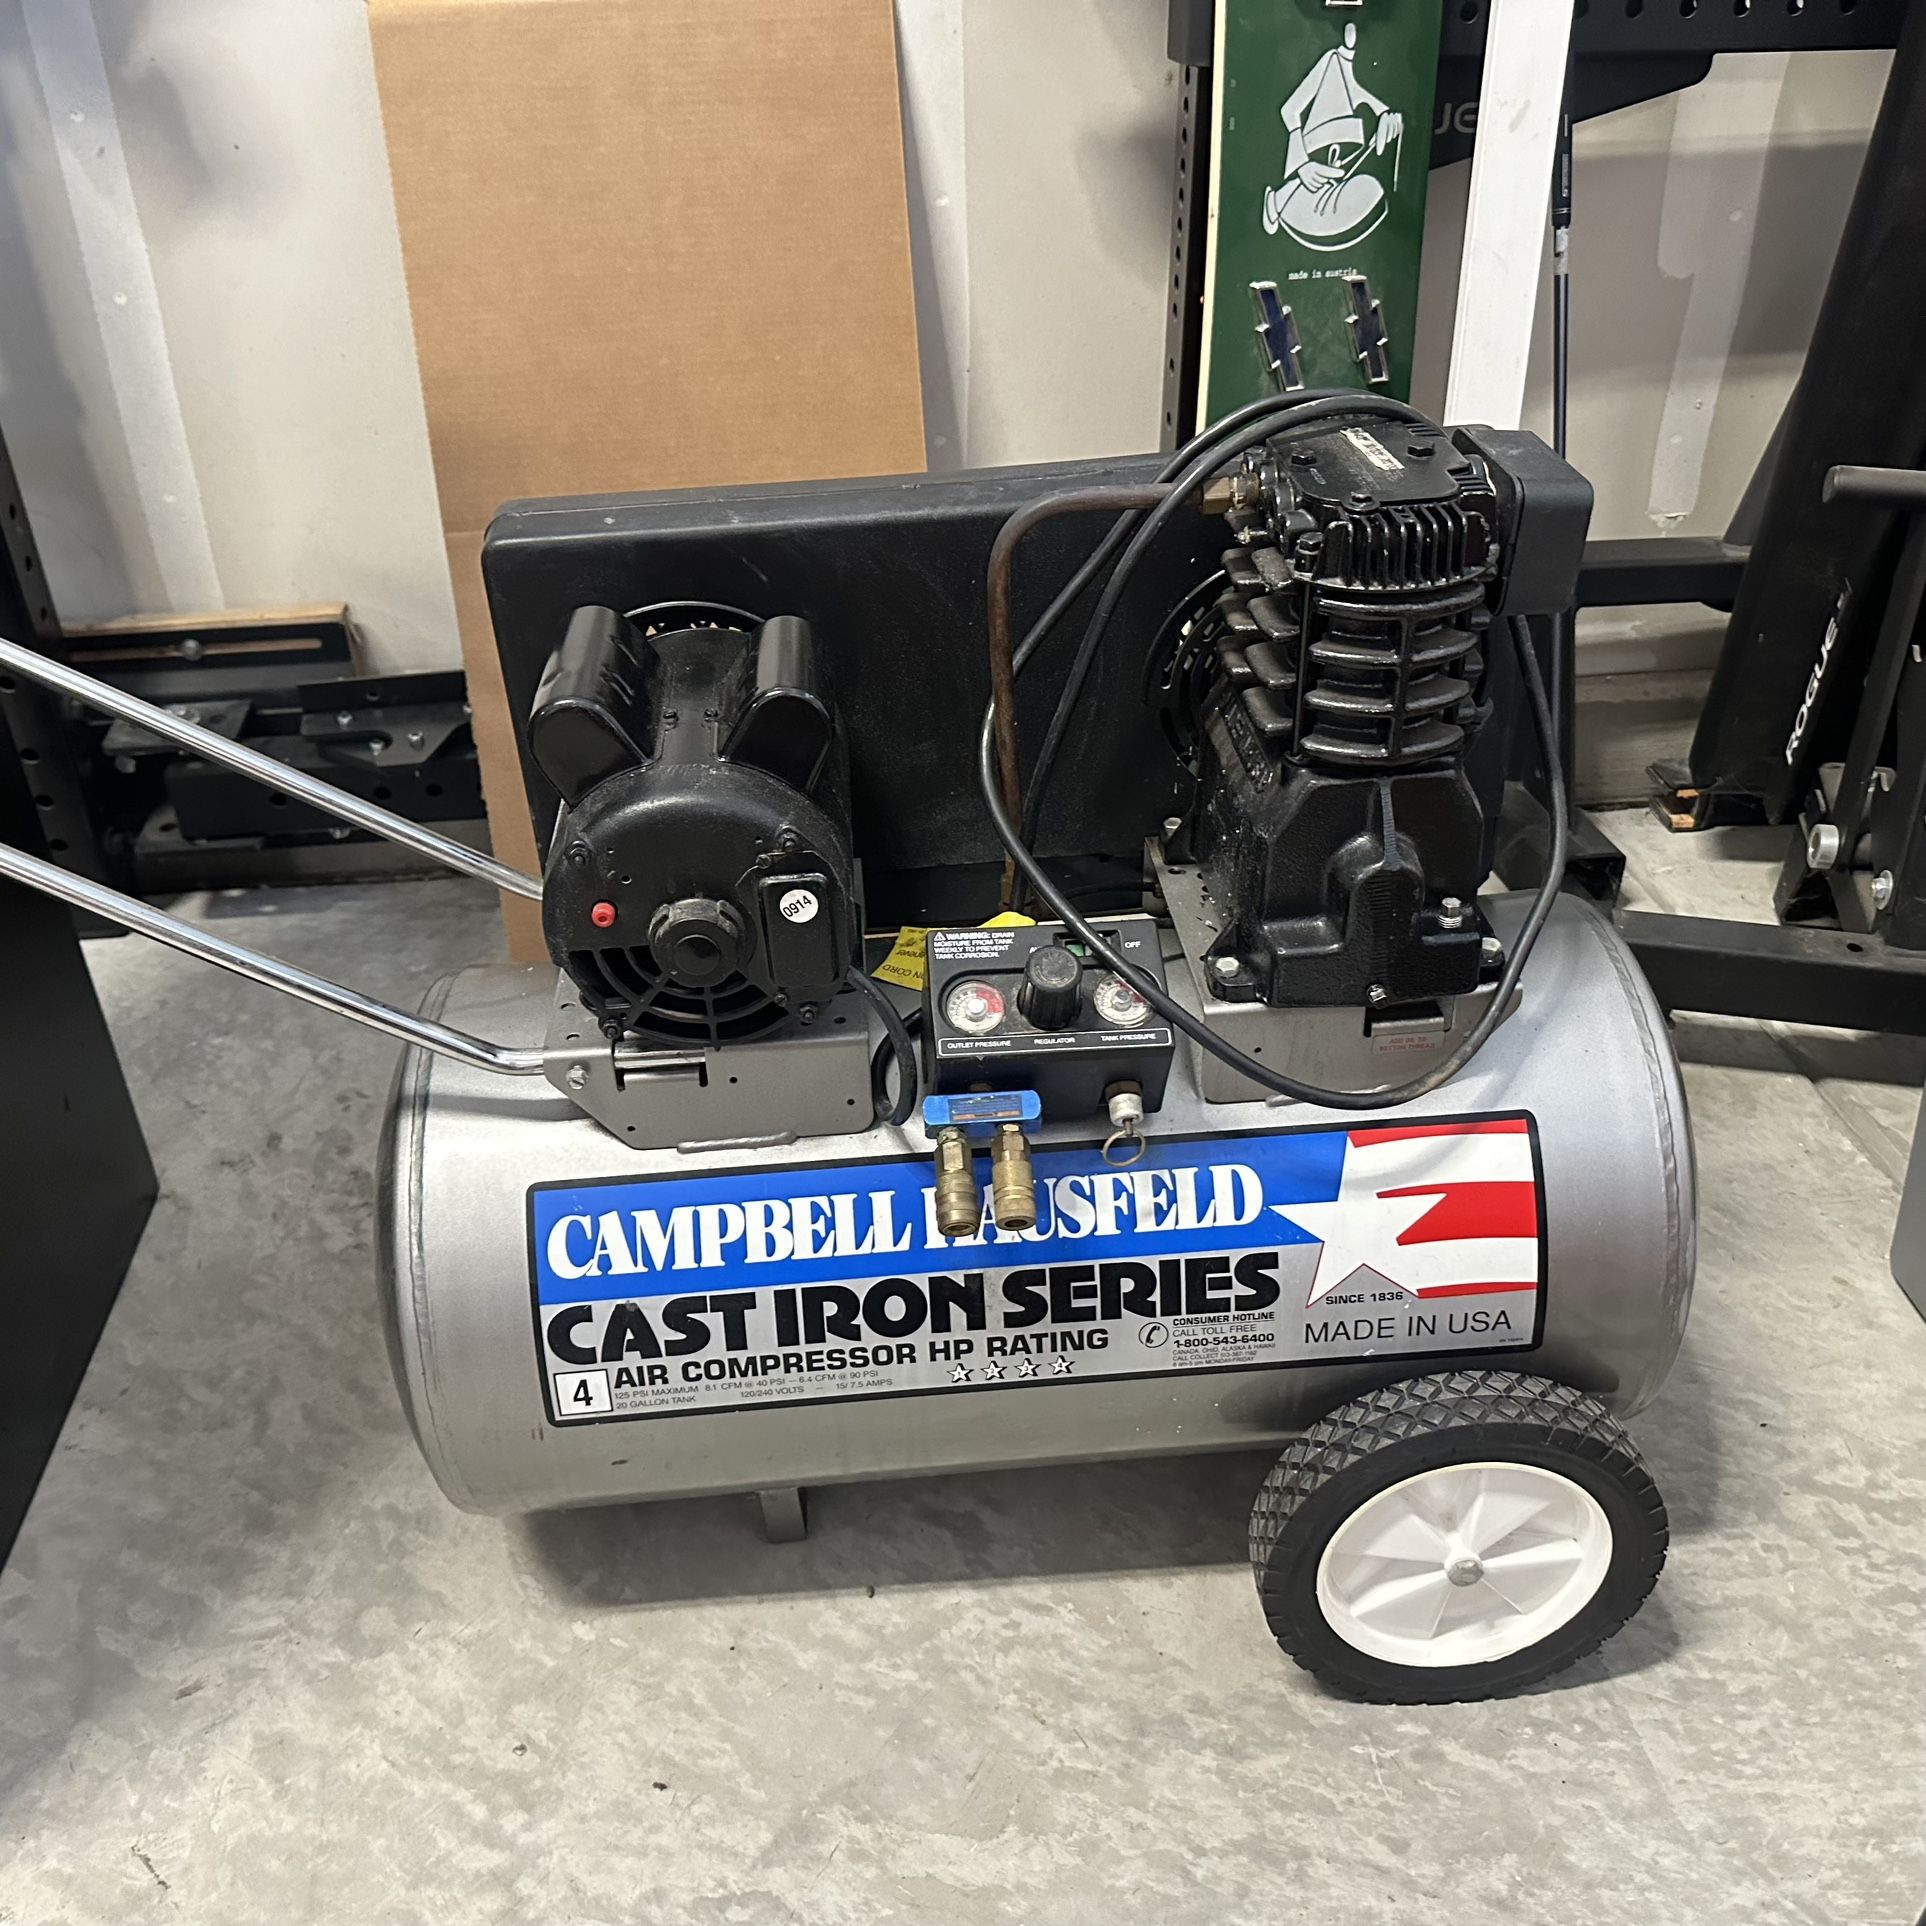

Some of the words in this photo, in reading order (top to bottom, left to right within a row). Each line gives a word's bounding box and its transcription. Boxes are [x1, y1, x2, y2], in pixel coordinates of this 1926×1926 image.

[1288, 270, 1308, 280] made
[1312, 269, 1322, 278] in
[1786, 617, 1838, 766] ROGUE
[783, 895, 812, 917] 0914
[946, 932, 990, 940] WARNING:
[882, 964, 912, 976] CORD
[947, 1041, 973, 1049] OUTLET
[974, 1040, 1011, 1048] PRESSURE
[1034, 1037, 1076, 1045] REGULATOR
[547, 1190, 912, 1280] CAMPBELL
[1325, 1294, 1365, 1305] SINCE
[1371, 1291, 1404, 1302] 1836
[548, 1292, 756, 1365] CAST
[774, 1273, 986, 1347] IRON
[1002, 1252, 1281, 1329] SERIES
[1173, 1315, 1230, 1326] CONSUMER
[1232, 1312, 1275, 1321] HOTLINE
[1304, 1317, 1396, 1344] MADE
[1407, 1314, 1436, 1337] IN
[1449, 1310, 1512, 1334] USA
[1172, 1329, 1198, 1337] CALL
[1201, 1327, 1225, 1335] TOLL
[1229, 1324, 1256, 1332] FREE
[1173, 1333, 1275, 1348] 1-800-543-6400
[614, 1364, 669, 1389] AIR
[681, 1342, 916, 1382] COMPRESSOR
[929, 1339, 973, 1361] HP
[987, 1328, 1109, 1357] RATING
[573, 1379, 593, 1406] 4
[614, 1391, 630, 1399] 125
[651, 1385, 699, 1396] MAXIMUM
[721, 1382, 742, 1390] CFM
[630, 1398, 669, 1408] GALLON
[671, 1395, 697, 1403] TANK
[740, 1389, 773, 1398] 120/240
[775, 1386, 805, 1394] VOLTS
[866, 1378, 893, 1386] AMPS
